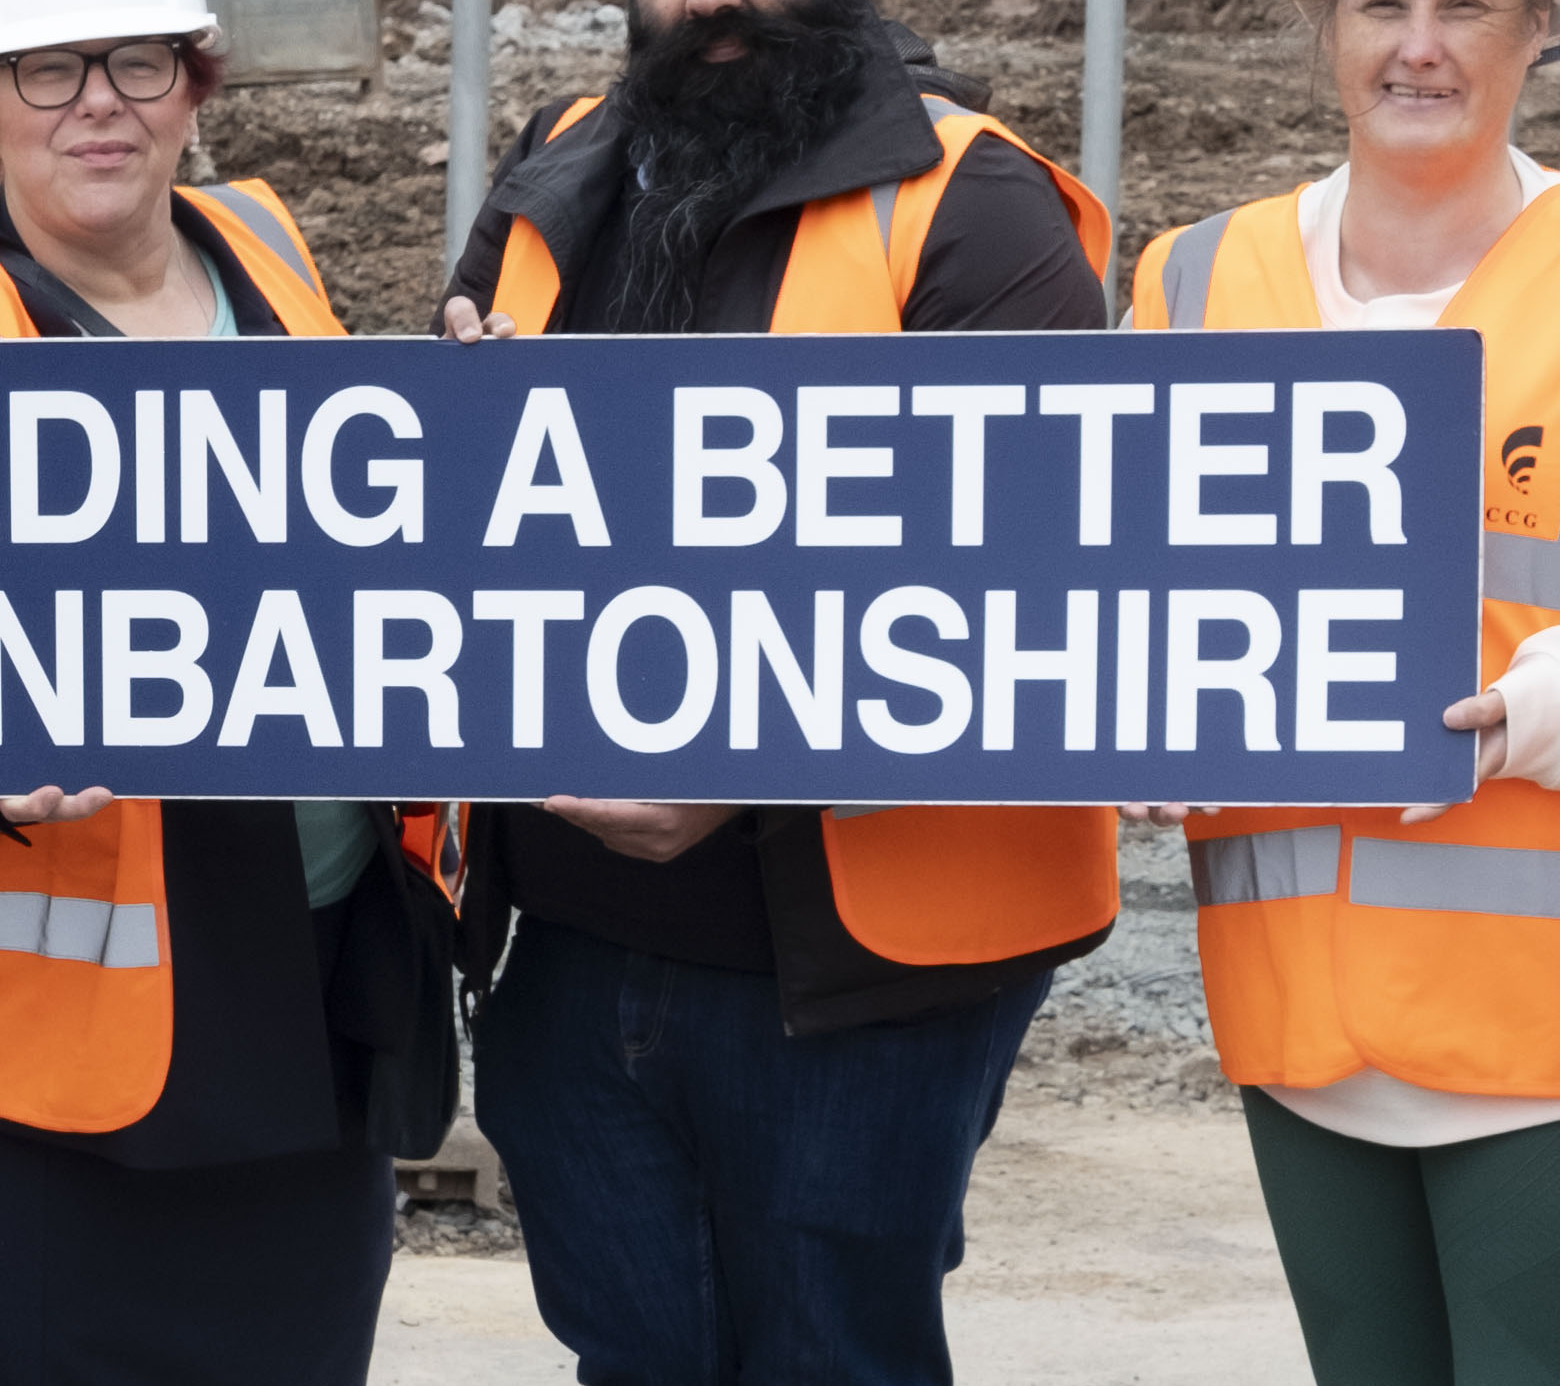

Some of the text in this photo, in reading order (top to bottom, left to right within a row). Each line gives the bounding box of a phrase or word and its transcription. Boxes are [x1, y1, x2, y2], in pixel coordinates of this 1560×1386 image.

[484, 388, 613, 547] A
[673, 381, 1408, 546] BETTER
[1486, 507, 1538, 529] CCG
